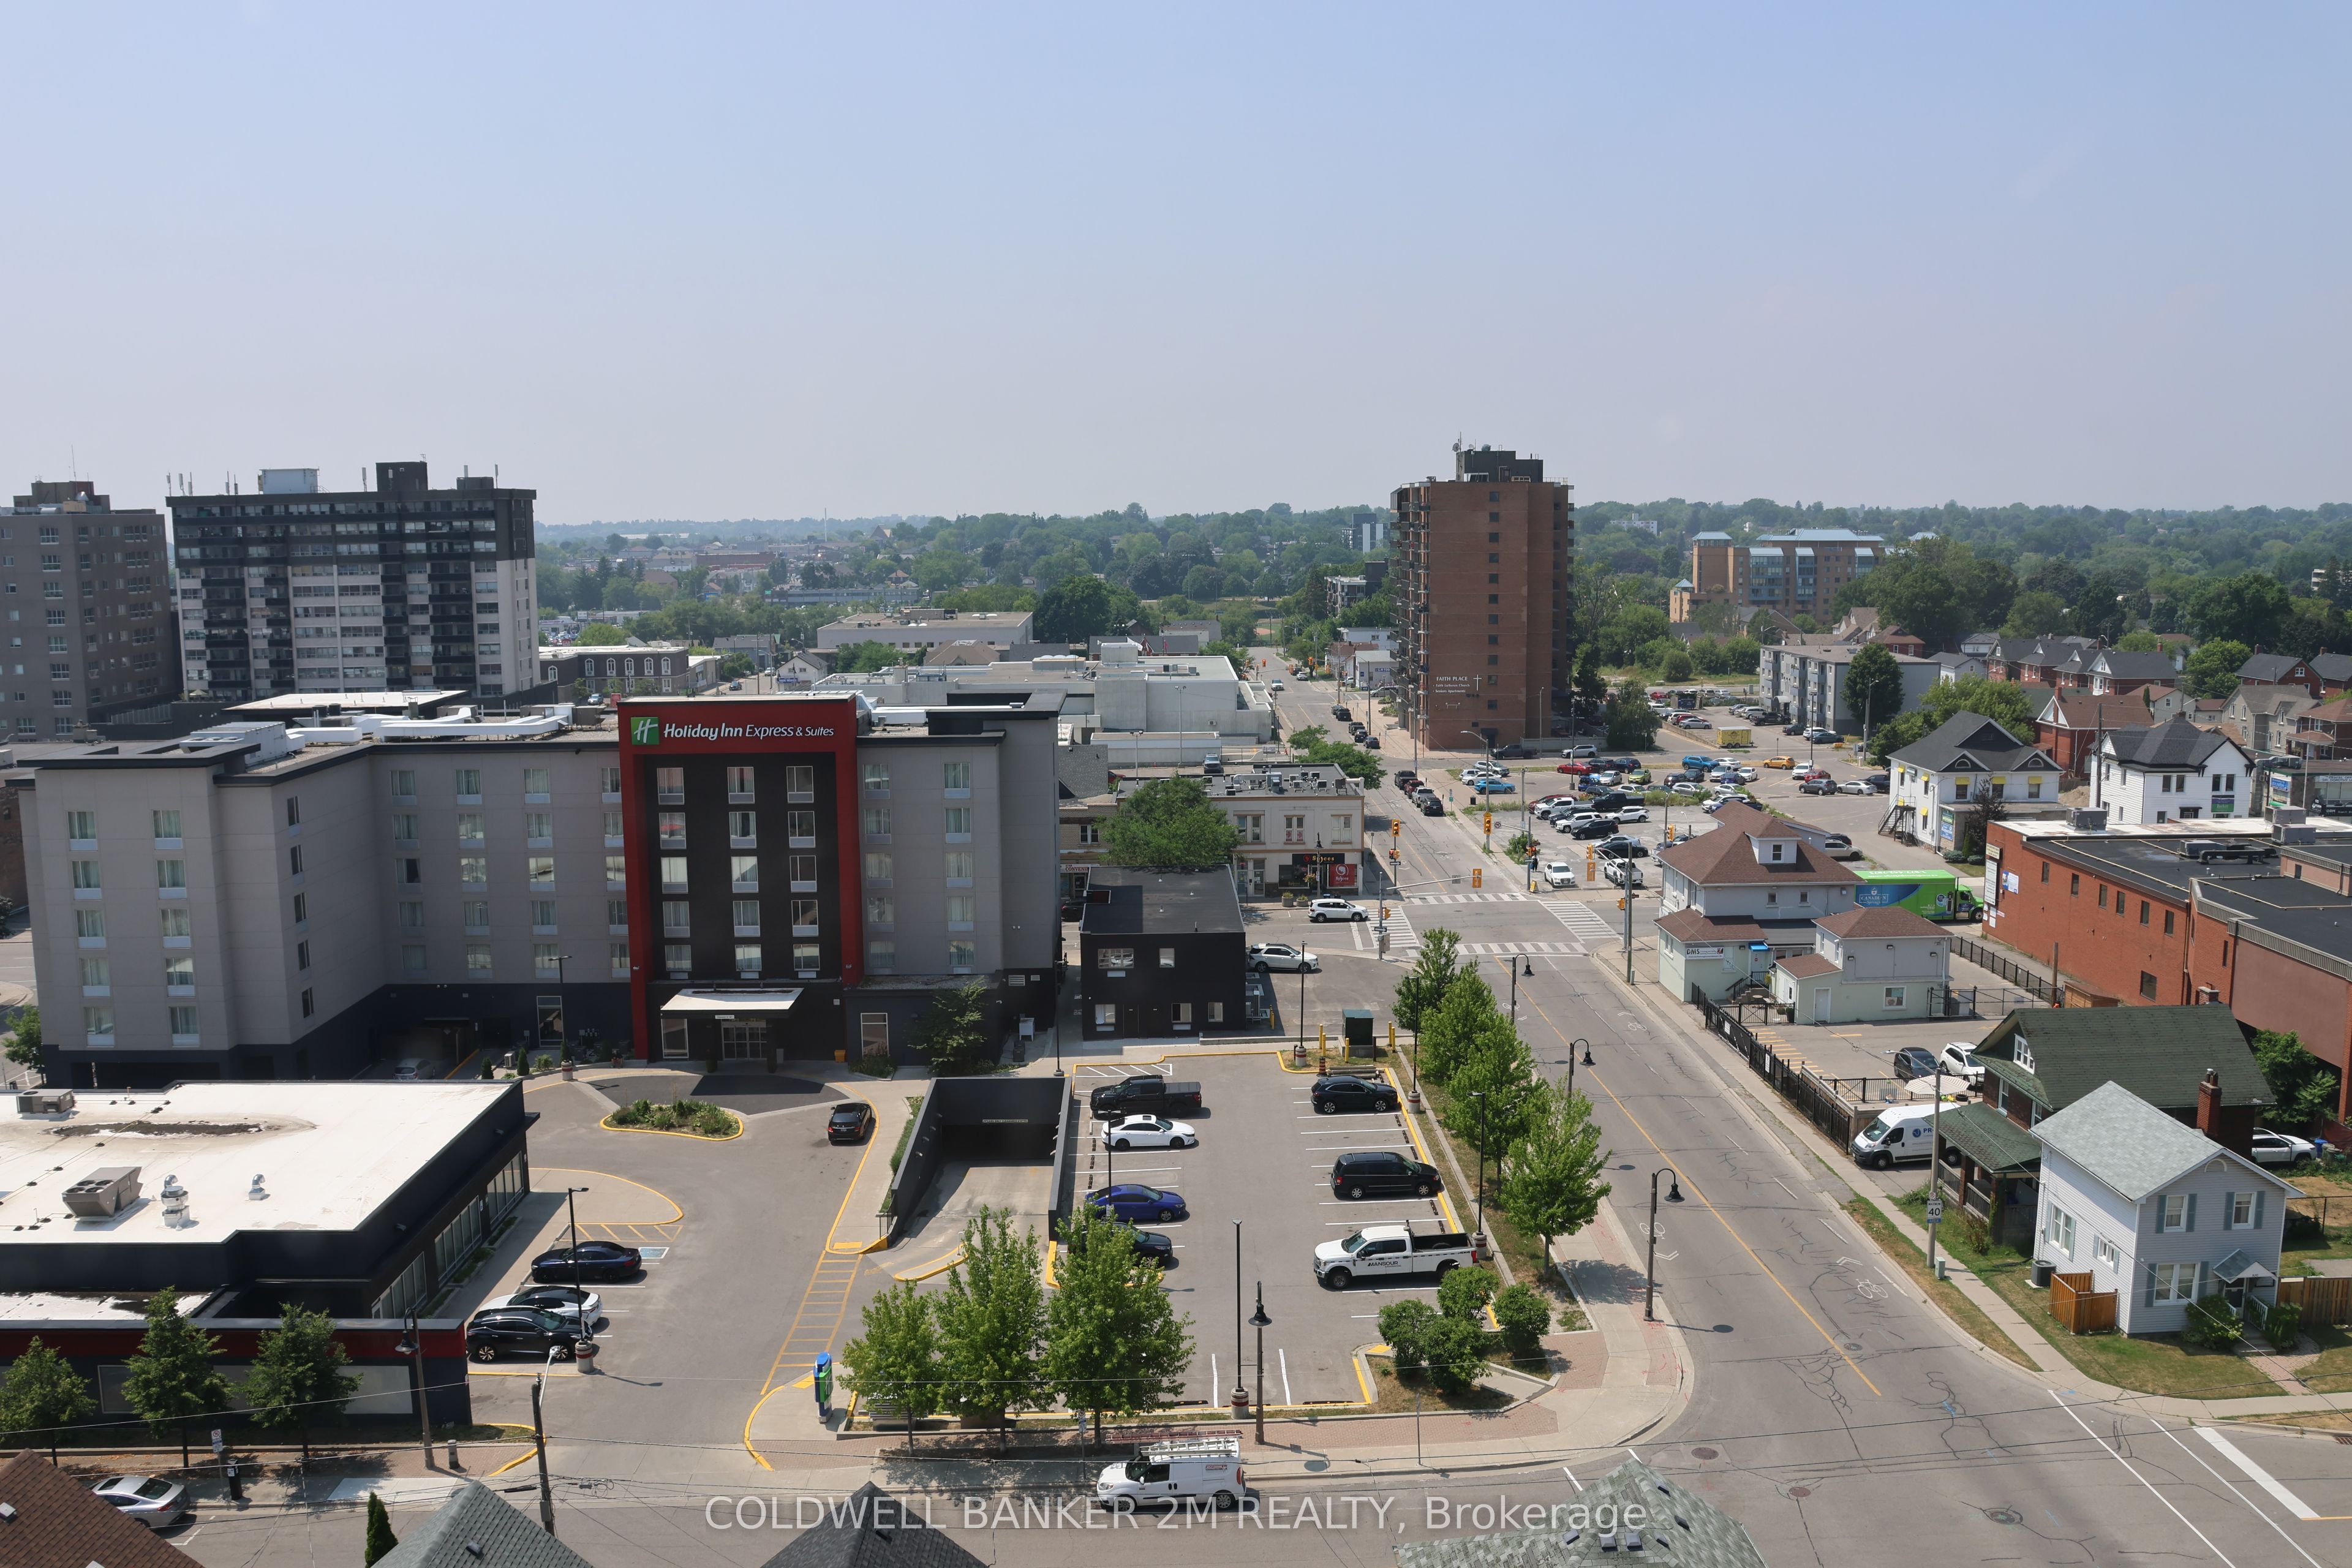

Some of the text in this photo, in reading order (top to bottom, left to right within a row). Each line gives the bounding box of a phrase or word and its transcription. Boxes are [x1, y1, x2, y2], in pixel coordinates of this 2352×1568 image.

[663, 723, 834, 741] Holiday Inn Express & Suites
